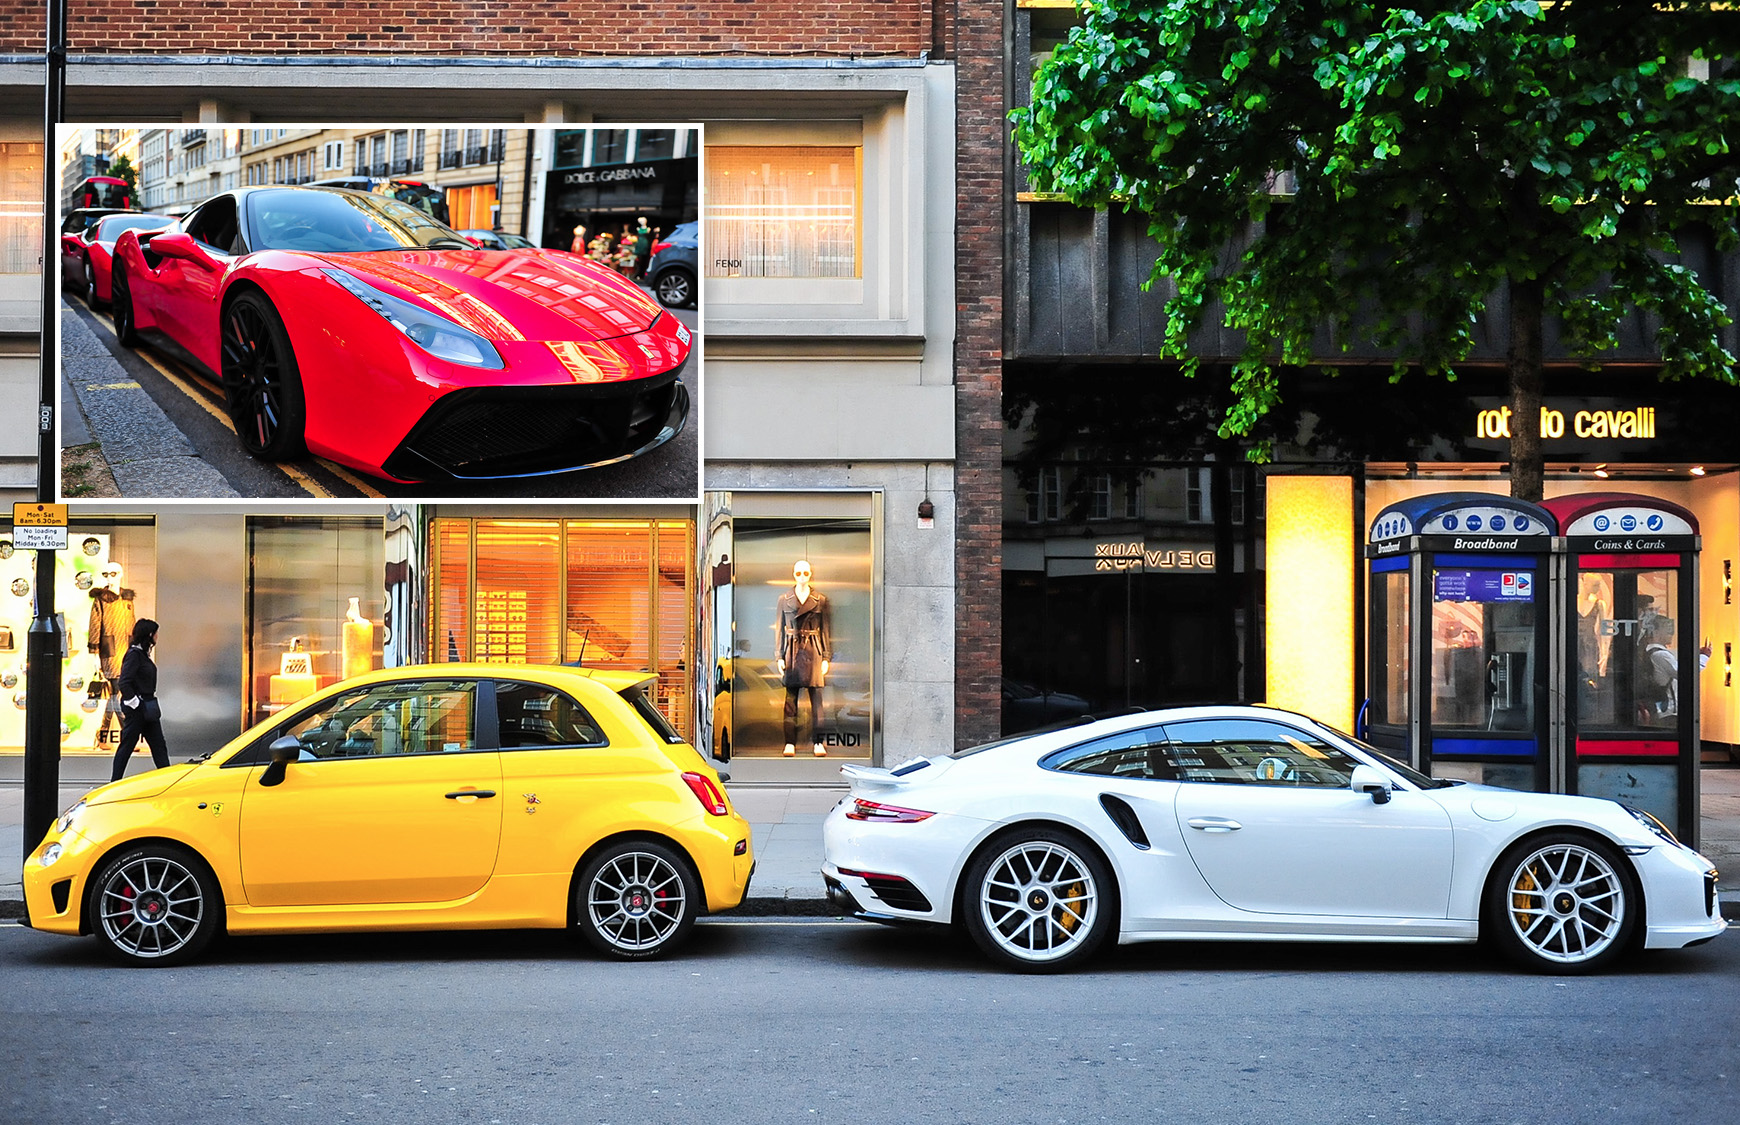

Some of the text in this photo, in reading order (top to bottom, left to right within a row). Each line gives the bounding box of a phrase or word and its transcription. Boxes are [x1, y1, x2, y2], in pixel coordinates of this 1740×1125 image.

[564, 172, 595, 184] DOLCE
[600, 166, 656, 182] GABBANA
[715, 259, 742, 268] FENDI
[1574, 407, 1656, 438] cavalli
[1378, 541, 1400, 554] Broadband
[1454, 538, 1518, 549] Broadband
[1594, 540, 1665, 550] Coins & Cards
[1601, 619, 1638, 636] BT
[816, 733, 861, 747] FENDI
